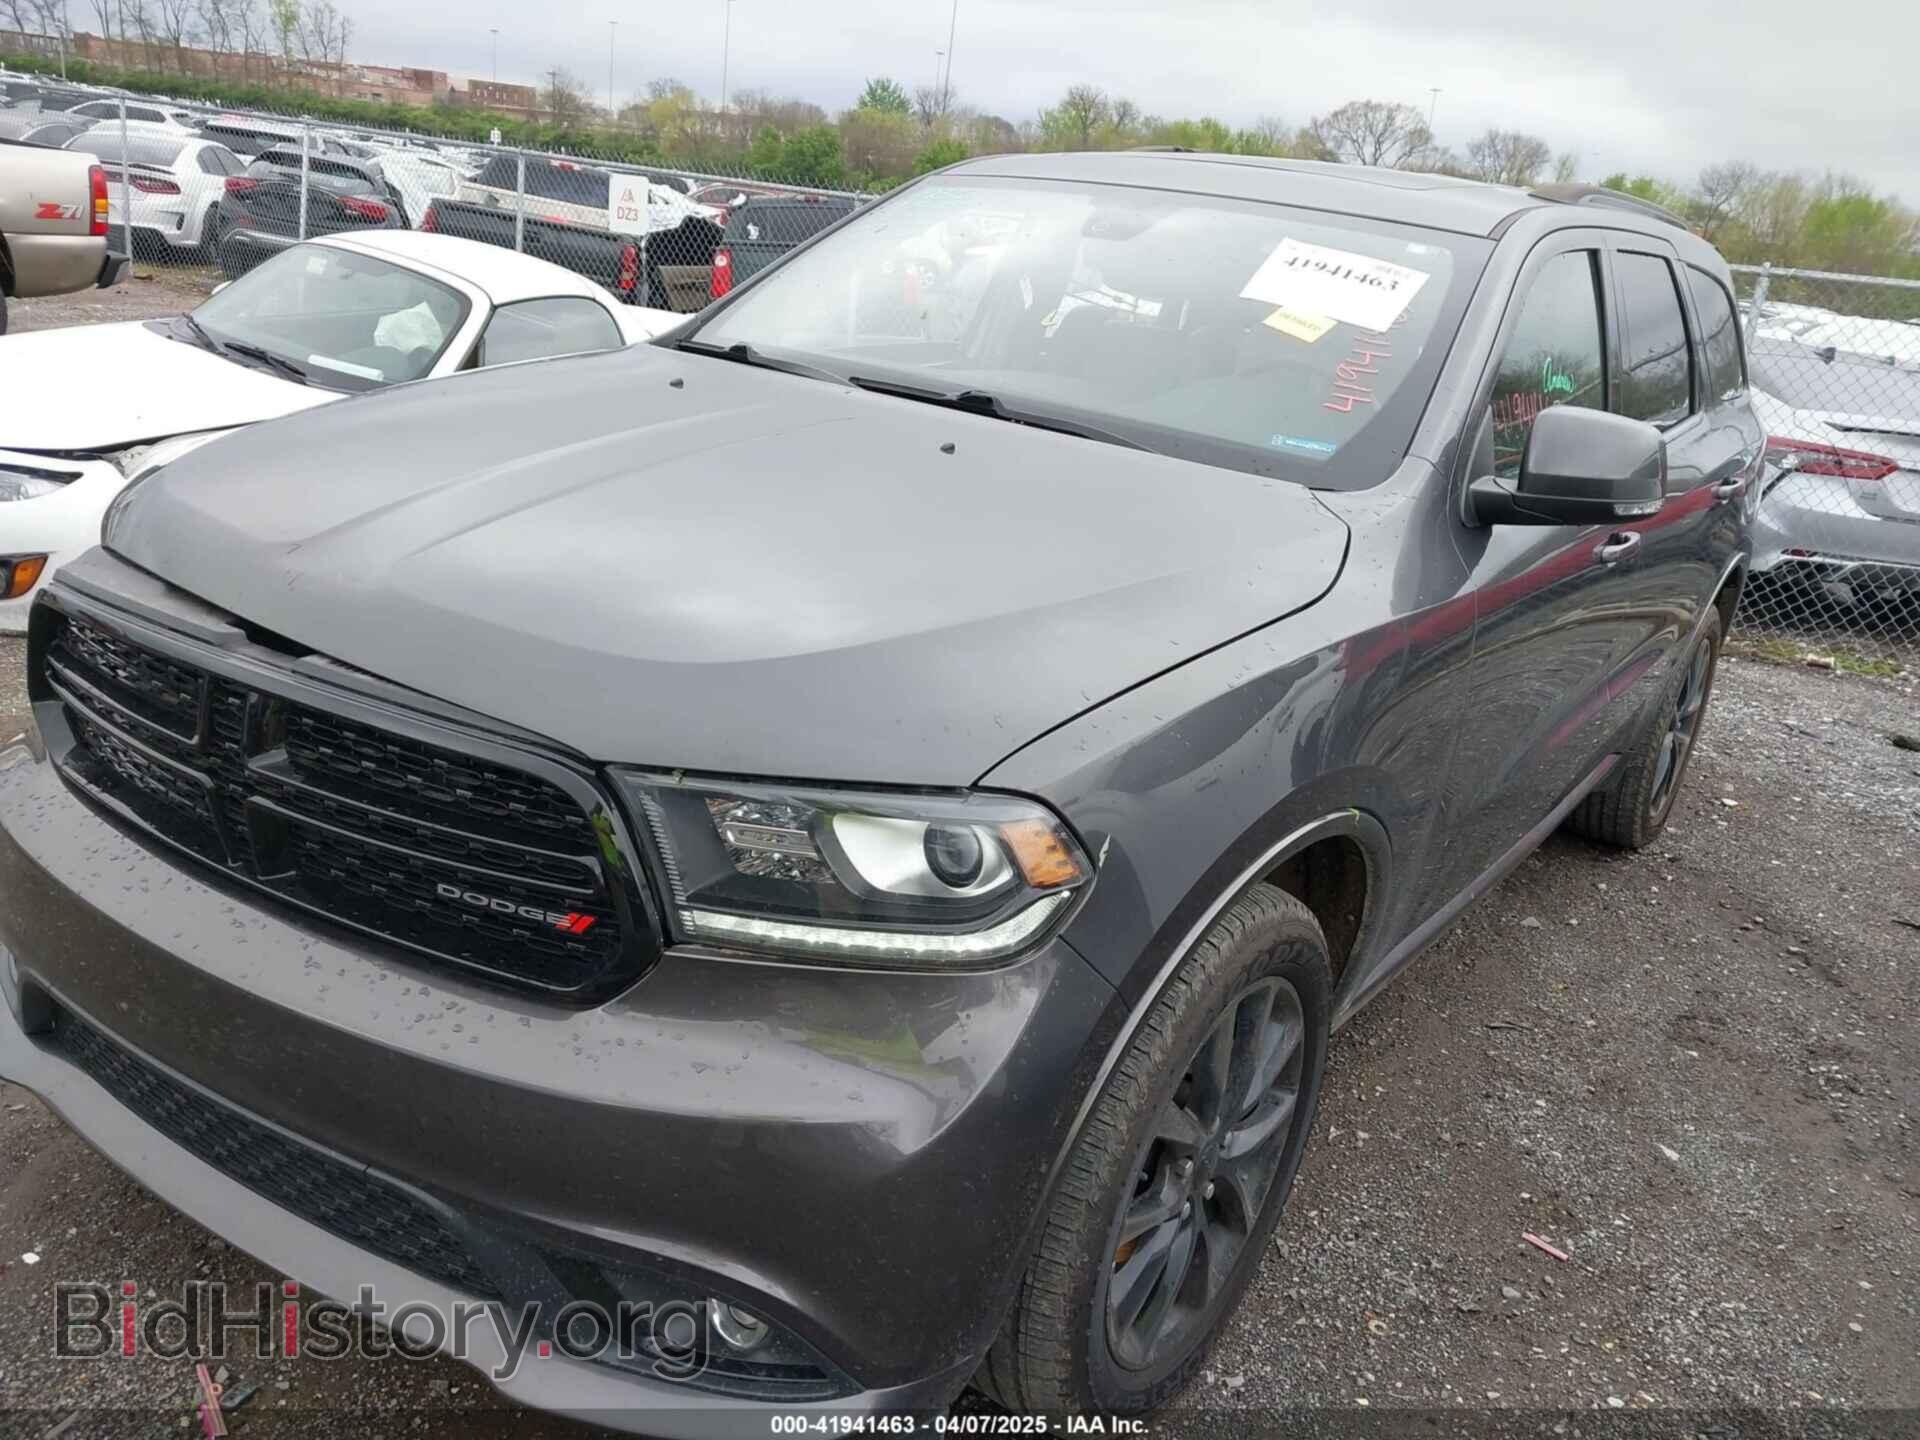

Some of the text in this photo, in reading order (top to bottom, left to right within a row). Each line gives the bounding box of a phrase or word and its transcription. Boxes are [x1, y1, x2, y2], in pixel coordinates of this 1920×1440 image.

[33, 202, 84, 220] Z71
[616, 206, 639, 221] DZ3
[1284, 256, 1399, 291] 41941463
[437, 883, 573, 928] DODGE
